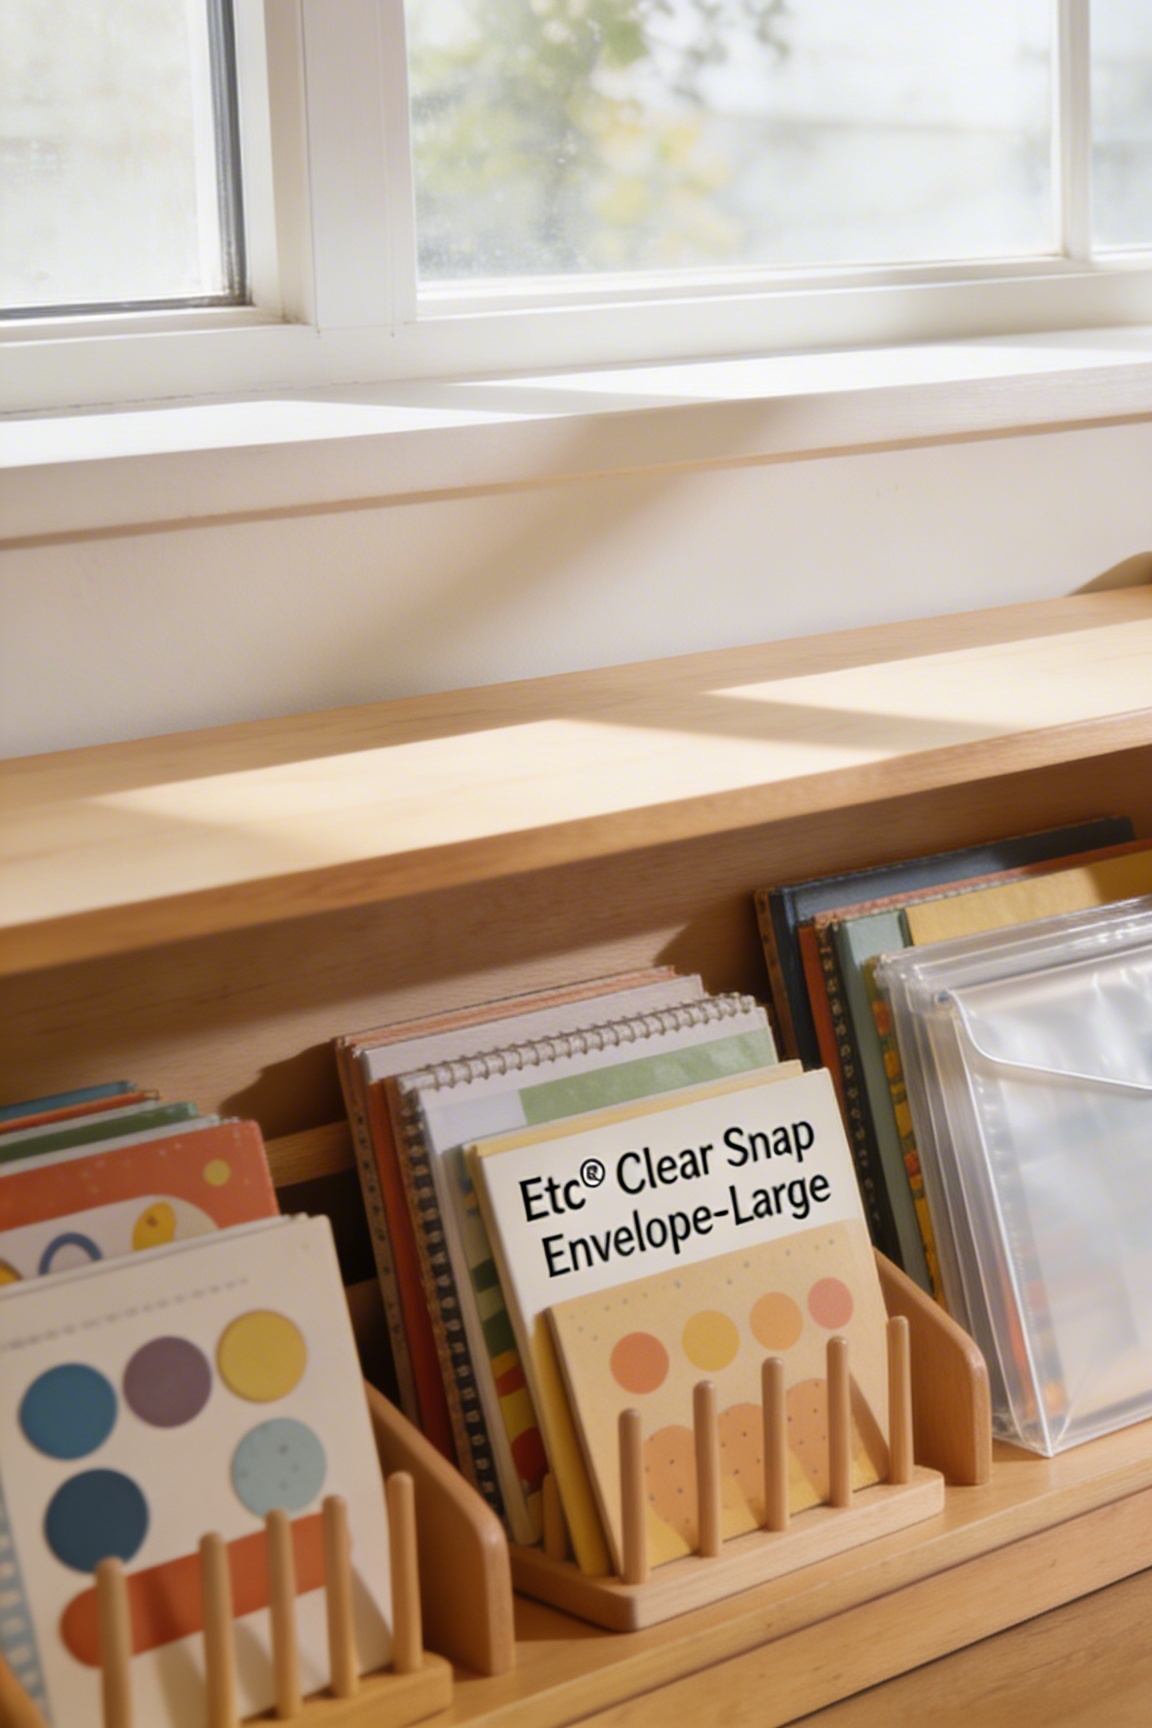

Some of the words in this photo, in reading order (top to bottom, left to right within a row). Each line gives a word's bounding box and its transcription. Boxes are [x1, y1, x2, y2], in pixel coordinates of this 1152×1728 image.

[616, 1144, 714, 1195] Clear
[723, 1120, 815, 1167] Snap
[541, 1173, 832, 1278] Envelope-Large
